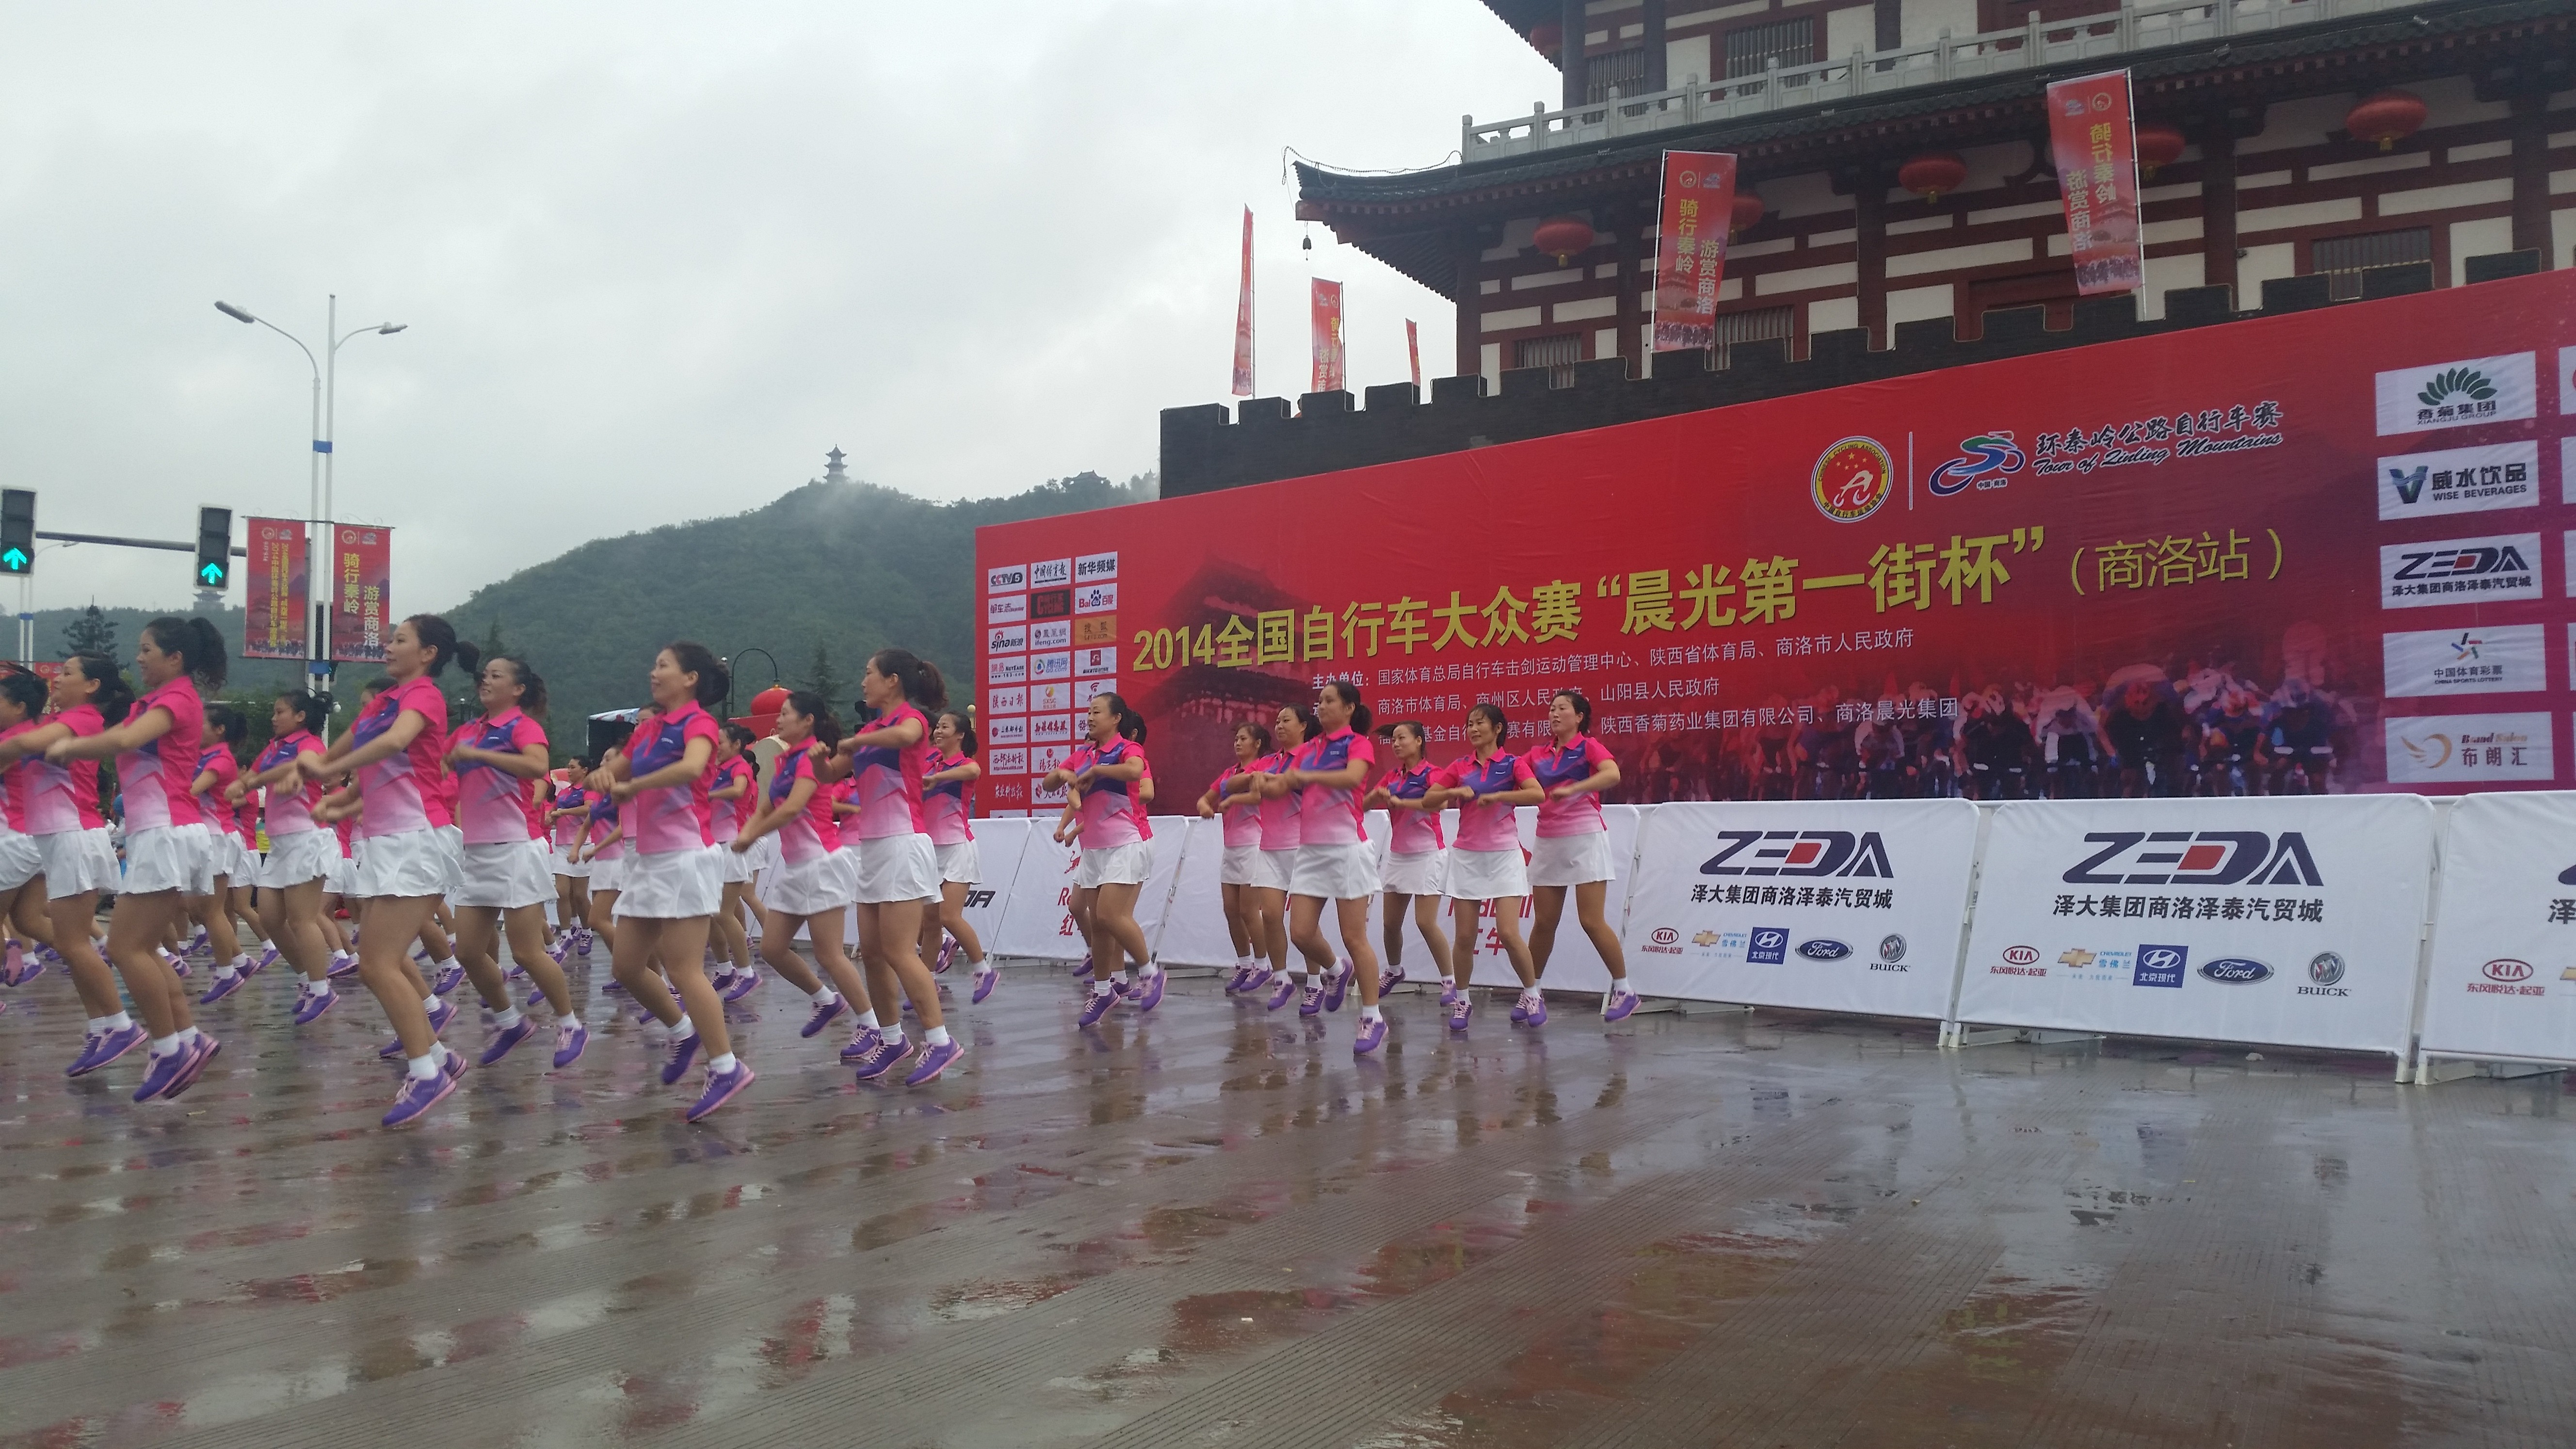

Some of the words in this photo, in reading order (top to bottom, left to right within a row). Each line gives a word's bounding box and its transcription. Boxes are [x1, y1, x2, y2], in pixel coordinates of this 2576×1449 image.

[1675, 199, 1699, 274] 骑行秦岭
[1696, 240, 1720, 315] 游赏商洛
[2036, 402, 2282, 455] 环秦岭公路自行车赛
[2417, 416, 2458, 425] XIANGJU
[2033, 457, 2074, 476] Tour
[2077, 455, 2095, 472] of
[2101, 445, 2170, 467] Qinling
[2177, 434, 2282, 457] Mountains
[2432, 463, 2526, 490] 威水饮品
[2433, 490, 2459, 500] WISE
[2464, 484, 2527, 498] BEVERAGES
[1078, 559, 1115, 576] 新华频媒
[2394, 546, 2529, 580] ZEDA
[344, 553, 360, 613] 骑行秦岭
[364, 585, 380, 647] 游赏商洛
[2434, 665, 2502, 677] 中国体育彩票
[2462, 747, 2527, 767] 布朗汇
[1700, 831, 1894, 878] ZEDA
[2062, 831, 2324, 886] ZEDA
[1690, 884, 1893, 909] 泽大集团商洛泽泰汽贸城
[2053, 894, 2324, 922] 泽大集团商洛泽泰汽贸城
[1656, 932, 1674, 941] KIA
[1752, 951, 1778, 960] 北京现代
[1807, 941, 1839, 958] Ford
[2010, 950, 2033, 961] KIA
[1870, 963, 1909, 972] BUICK
[2140, 973, 2175, 982] 北京现代
[2213, 960, 2255, 981] Ford
[2492, 965, 2524, 977] KIA
[2298, 986, 2350, 997] BUICK
